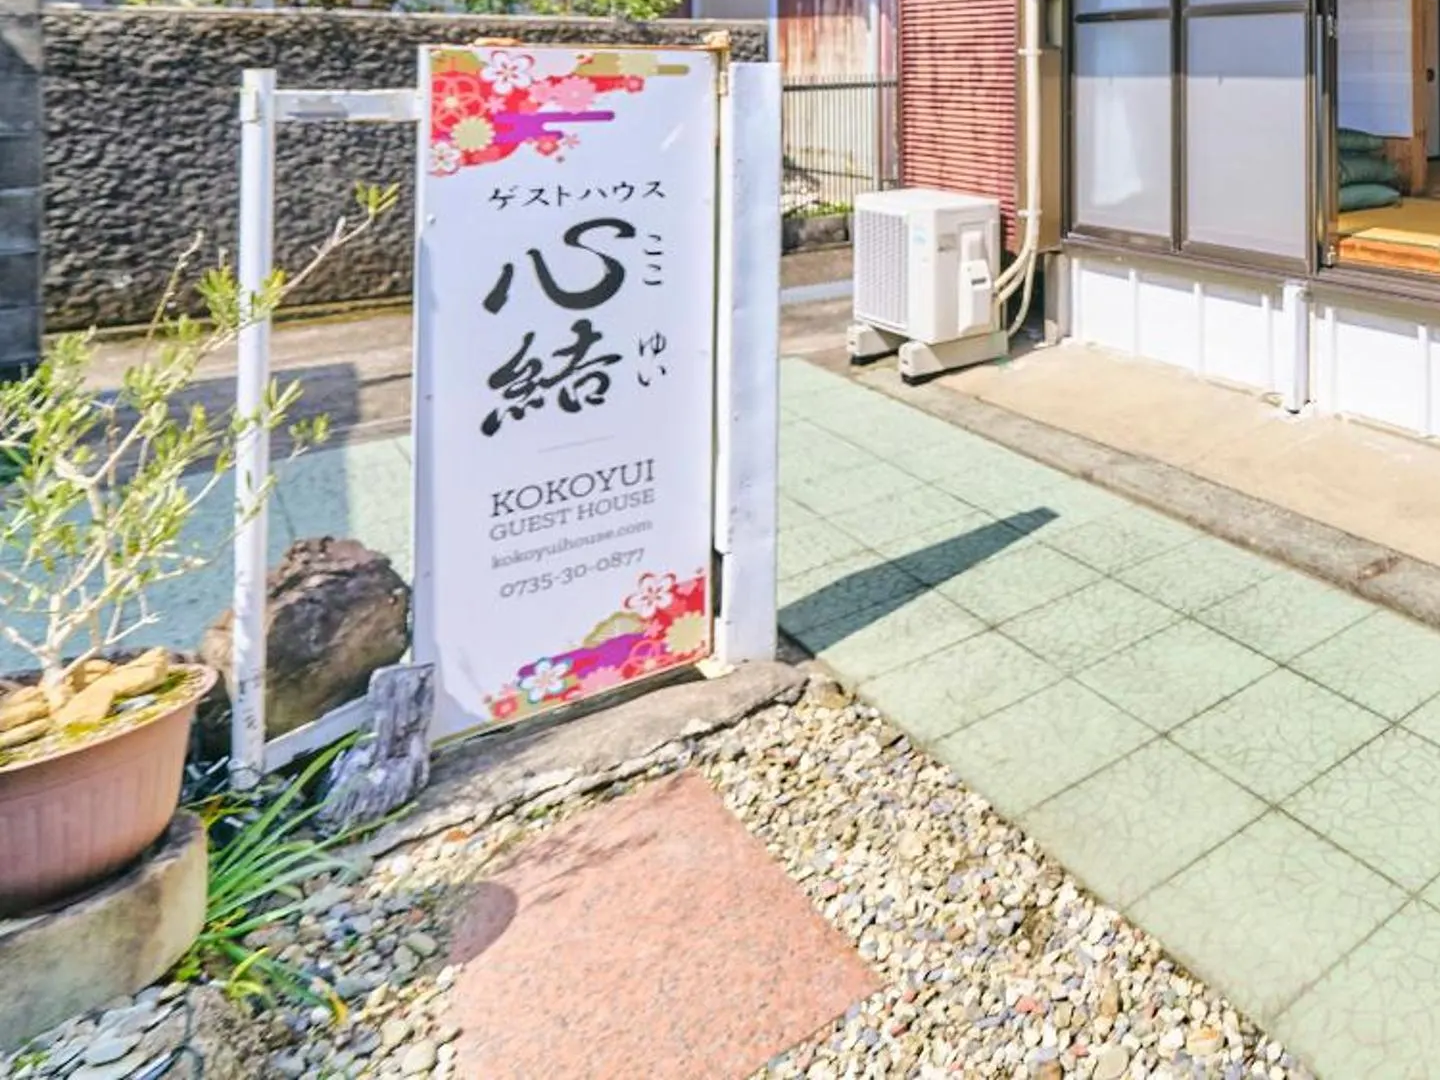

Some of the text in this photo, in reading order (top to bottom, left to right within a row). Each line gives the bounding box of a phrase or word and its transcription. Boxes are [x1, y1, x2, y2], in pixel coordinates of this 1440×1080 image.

[488, 180, 667, 210] ゲストハウス
[480, 217, 637, 437] 心結
[637, 233, 668, 387] ここ ゆい
[489, 488, 656, 542] GUEST HOUSE
[490, 459, 656, 518] KOKOYUI
[491, 520, 653, 570] kokoyuihouse.com
[499, 548, 646, 599] 0735-30-0877
